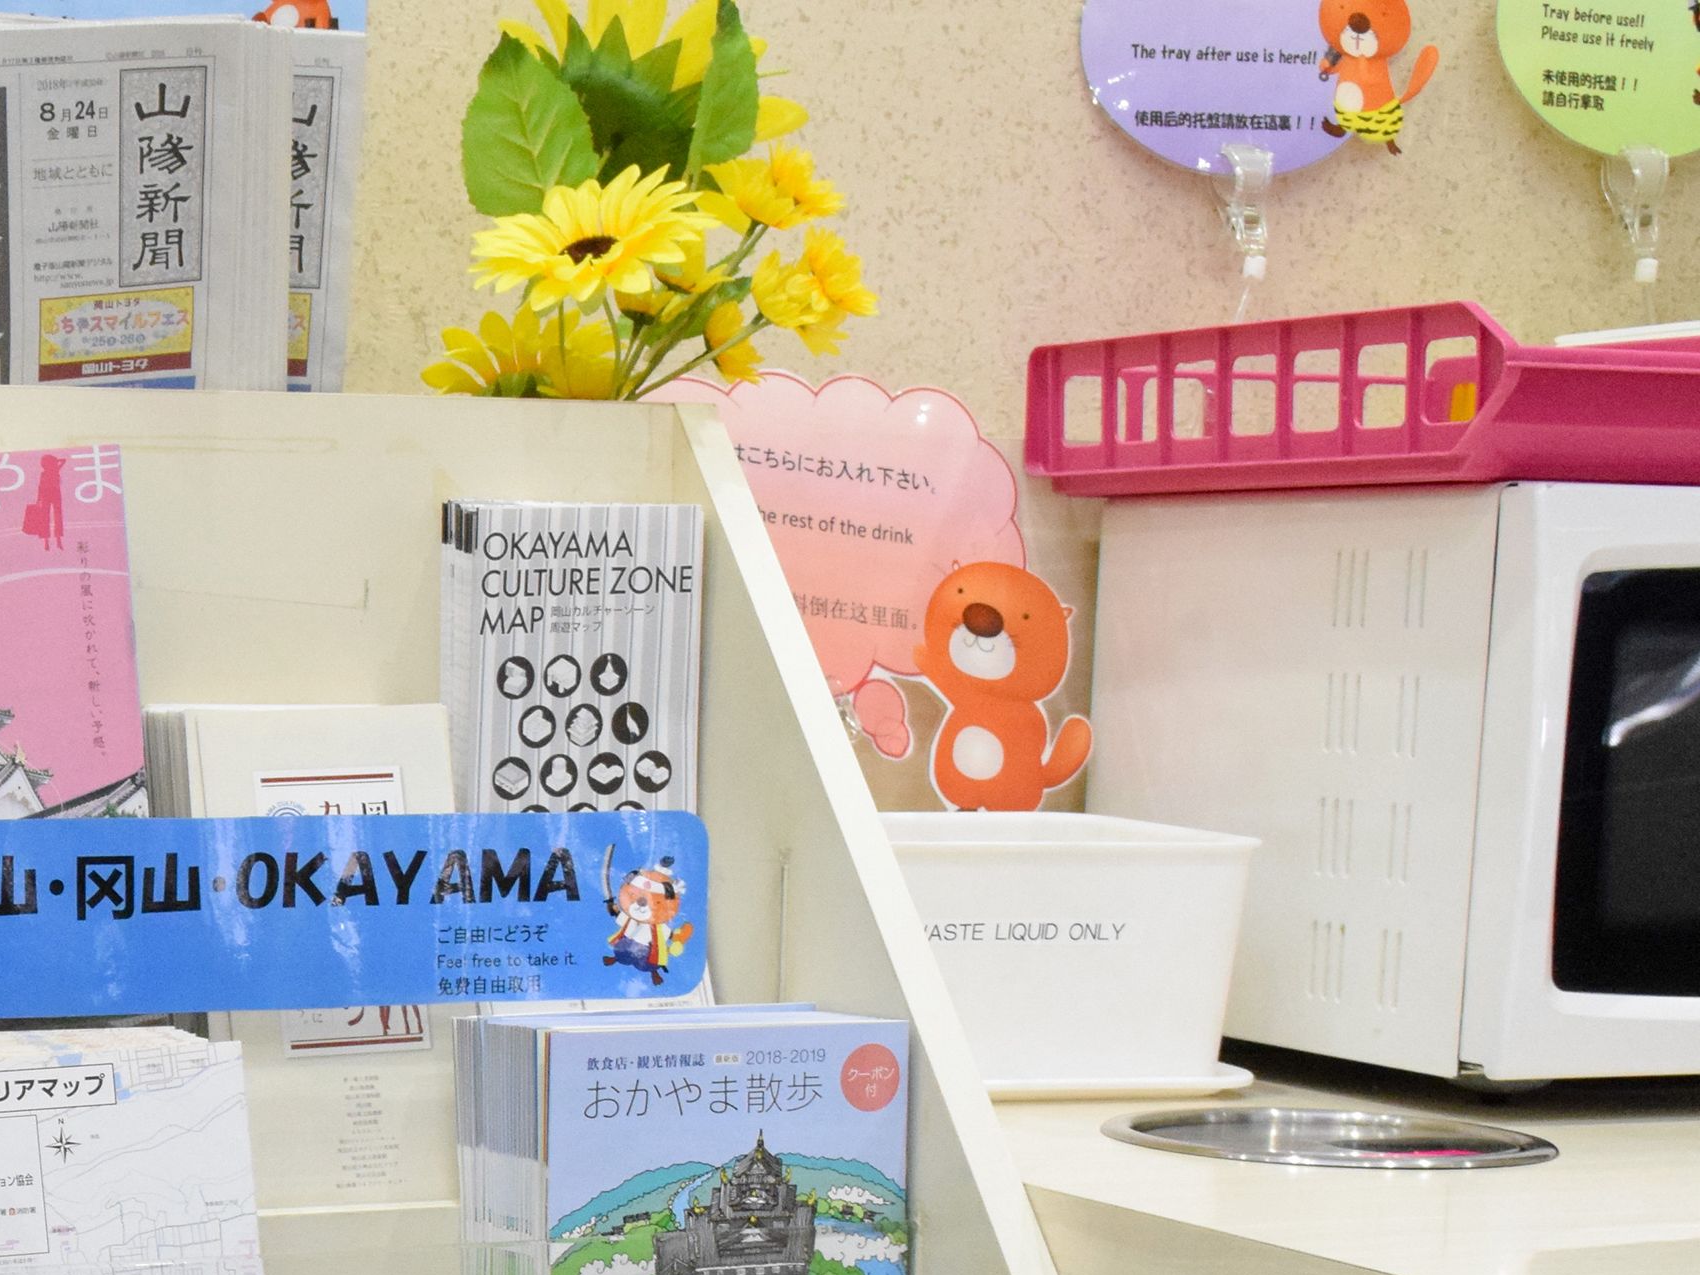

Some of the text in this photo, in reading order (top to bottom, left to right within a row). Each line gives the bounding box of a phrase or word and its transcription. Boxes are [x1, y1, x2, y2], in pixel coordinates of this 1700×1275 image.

[1542, 3, 1570, 22] Tray
[1574, 7, 1613, 25] before
[1541, 25, 1655, 53] Please use it freely
[1131, 43, 1318, 65] The tray after use is here!!
[39, 100, 109, 123] 8月24日
[46, 125, 98, 140] 金曜日
[32, 164, 114, 181] 地域とともに
[133, 82, 194, 271] 山陽新聞
[782, 510, 813, 530] rest
[818, 516, 836, 533] of
[840, 518, 867, 538] the
[872, 524, 914, 545] drink
[483, 530, 634, 561] OKAYAMA
[481, 565, 694, 599] CULTURE ZONE
[479, 606, 545, 636] MAP
[437, 923, 549, 945] ご自由にどうぞ
[923, 922, 1127, 942] ASTE LIQUID ONLY
[471, 953, 502, 968] free
[506, 954, 523, 968] to
[527, 952, 560, 967] take
[745, 1048, 826, 1067] 2018-2019
[846, 1064, 897, 1084] クーポン
[583, 1070, 825, 1121] おかやま散歩
[864, 1082, 879, 1099] 付
